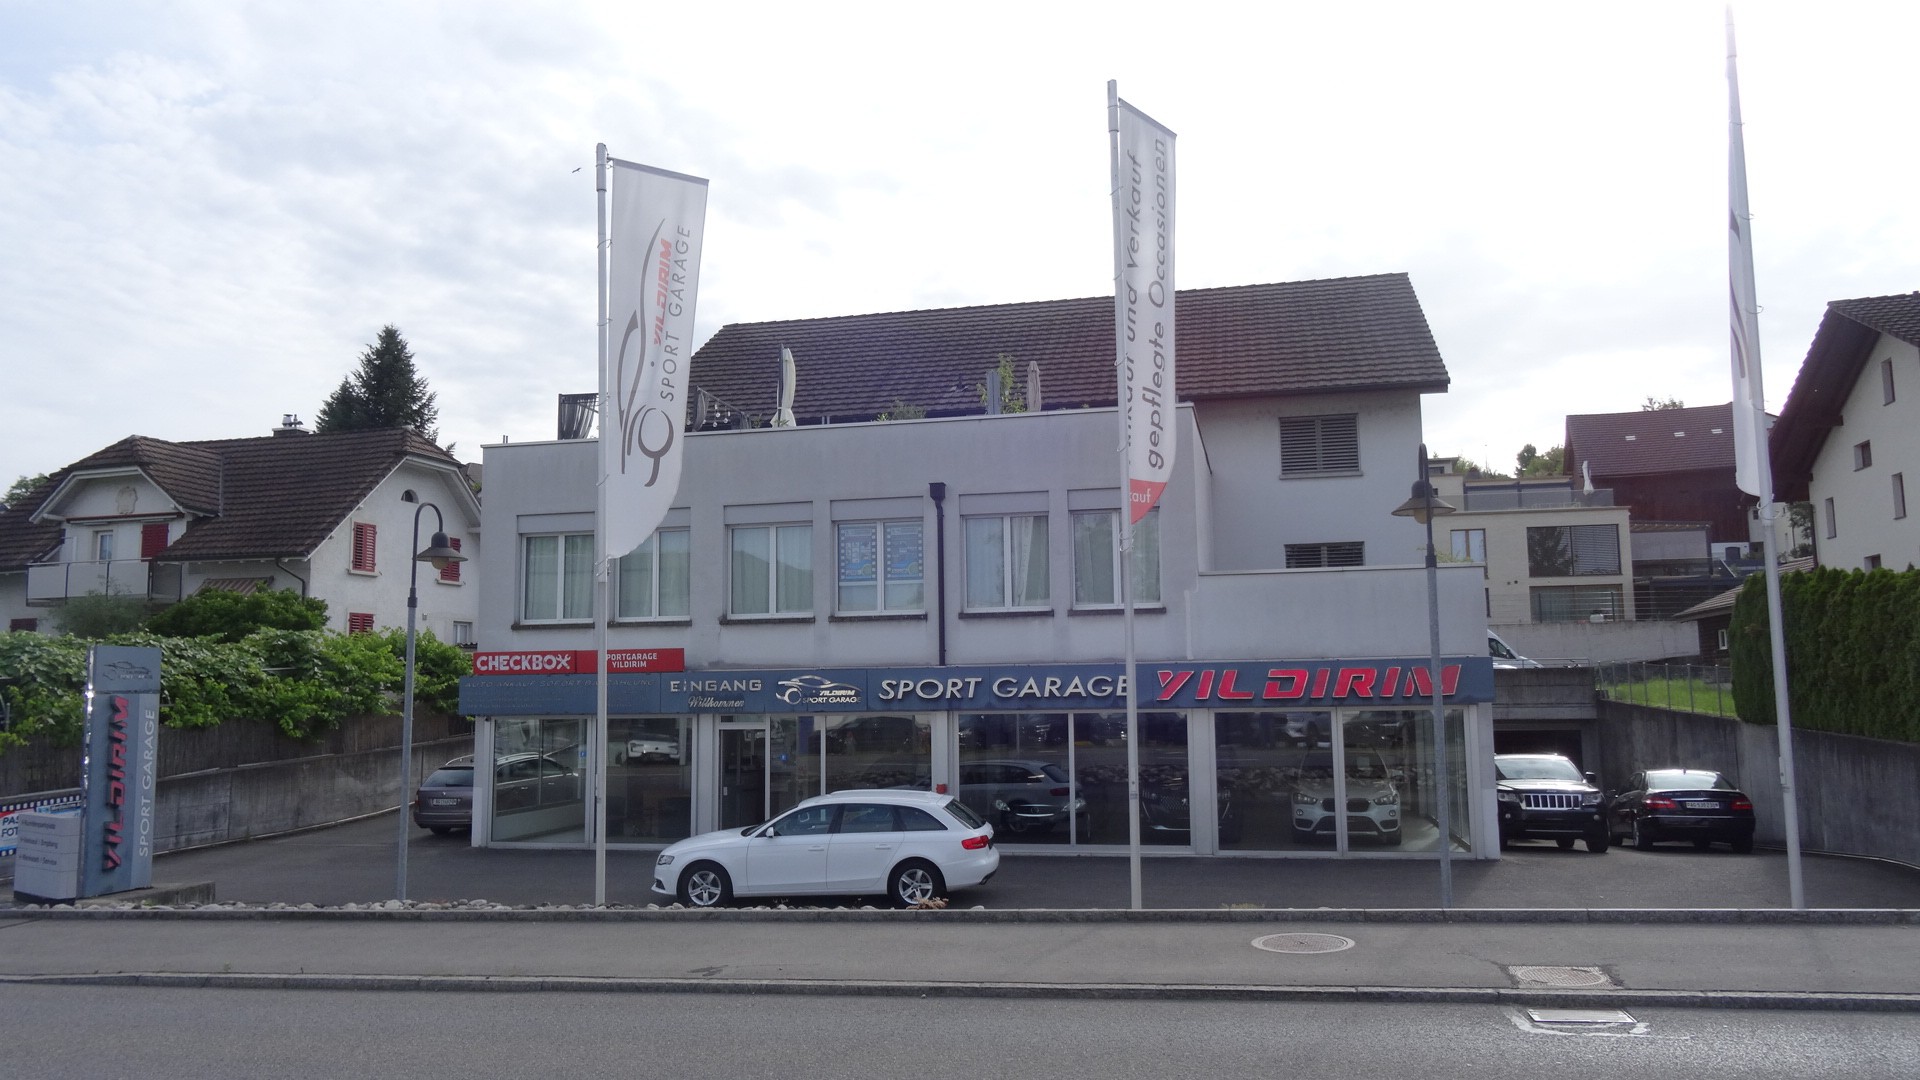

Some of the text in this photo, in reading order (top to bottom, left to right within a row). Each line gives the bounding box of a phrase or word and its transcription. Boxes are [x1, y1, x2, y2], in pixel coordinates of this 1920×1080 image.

[1126, 149, 1142, 269] Verkauf
[654, 238, 673, 346] YILDIRIM
[1142, 138, 1166, 470] gepflegte Occasionen
[660, 225, 691, 402] SPORT GARAGE
[1127, 281, 1138, 342] und
[476, 654, 571, 671] CHECKBOX
[607, 652, 657, 661] PORTGARAGE
[612, 660, 647, 668] YILDIRIM
[802, 696, 863, 704] SPORT GARAGE
[819, 689, 855, 697] YILDIRIM
[878, 675, 1128, 700] SPORT GARAGE
[1156, 664, 1462, 700] YILDIRIM
[688, 695, 744, 708] Willkommen
[105, 695, 129, 870] YILDIRIM
[139, 709, 155, 857] SPORT GARAGE
